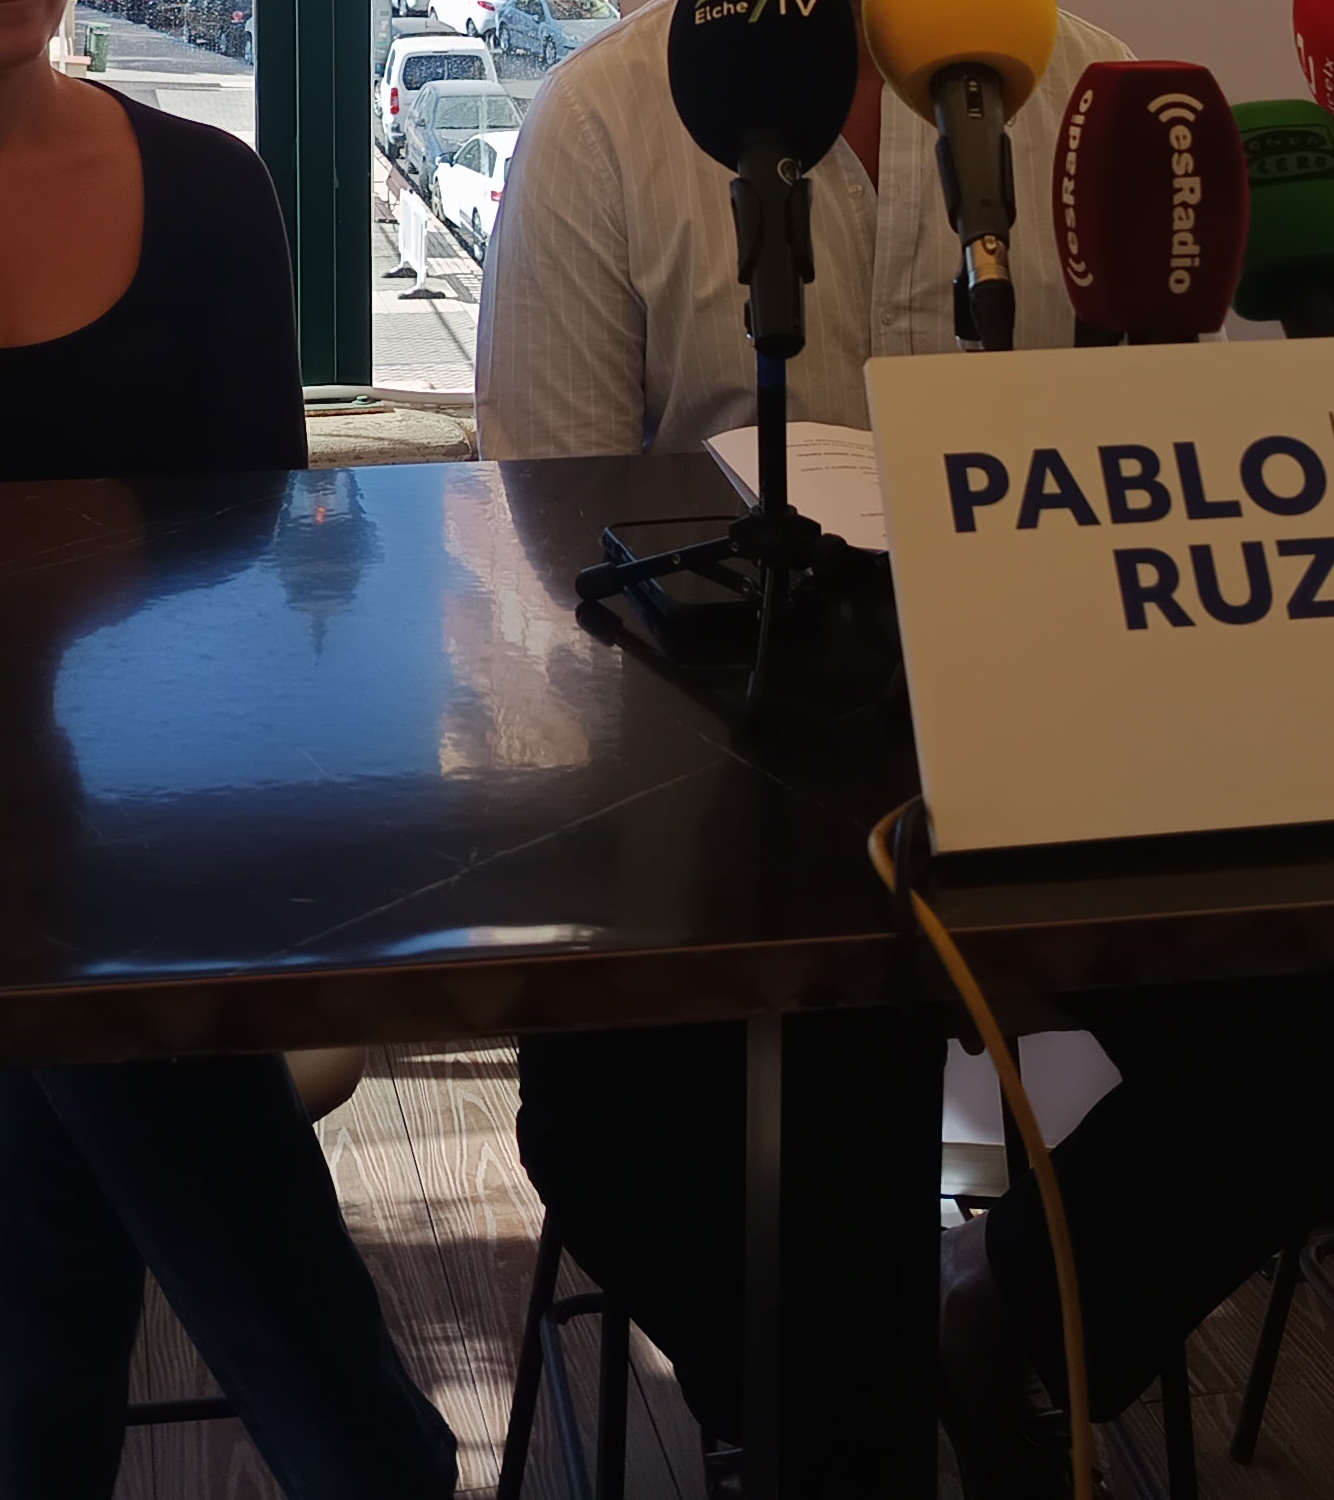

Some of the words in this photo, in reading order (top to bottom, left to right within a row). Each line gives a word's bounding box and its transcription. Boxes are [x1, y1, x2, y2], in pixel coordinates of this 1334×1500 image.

[1061, 88, 1094, 256] esRadio
[1169, 124, 1203, 295] esRadio
[943, 434, 1328, 534] PABLO
